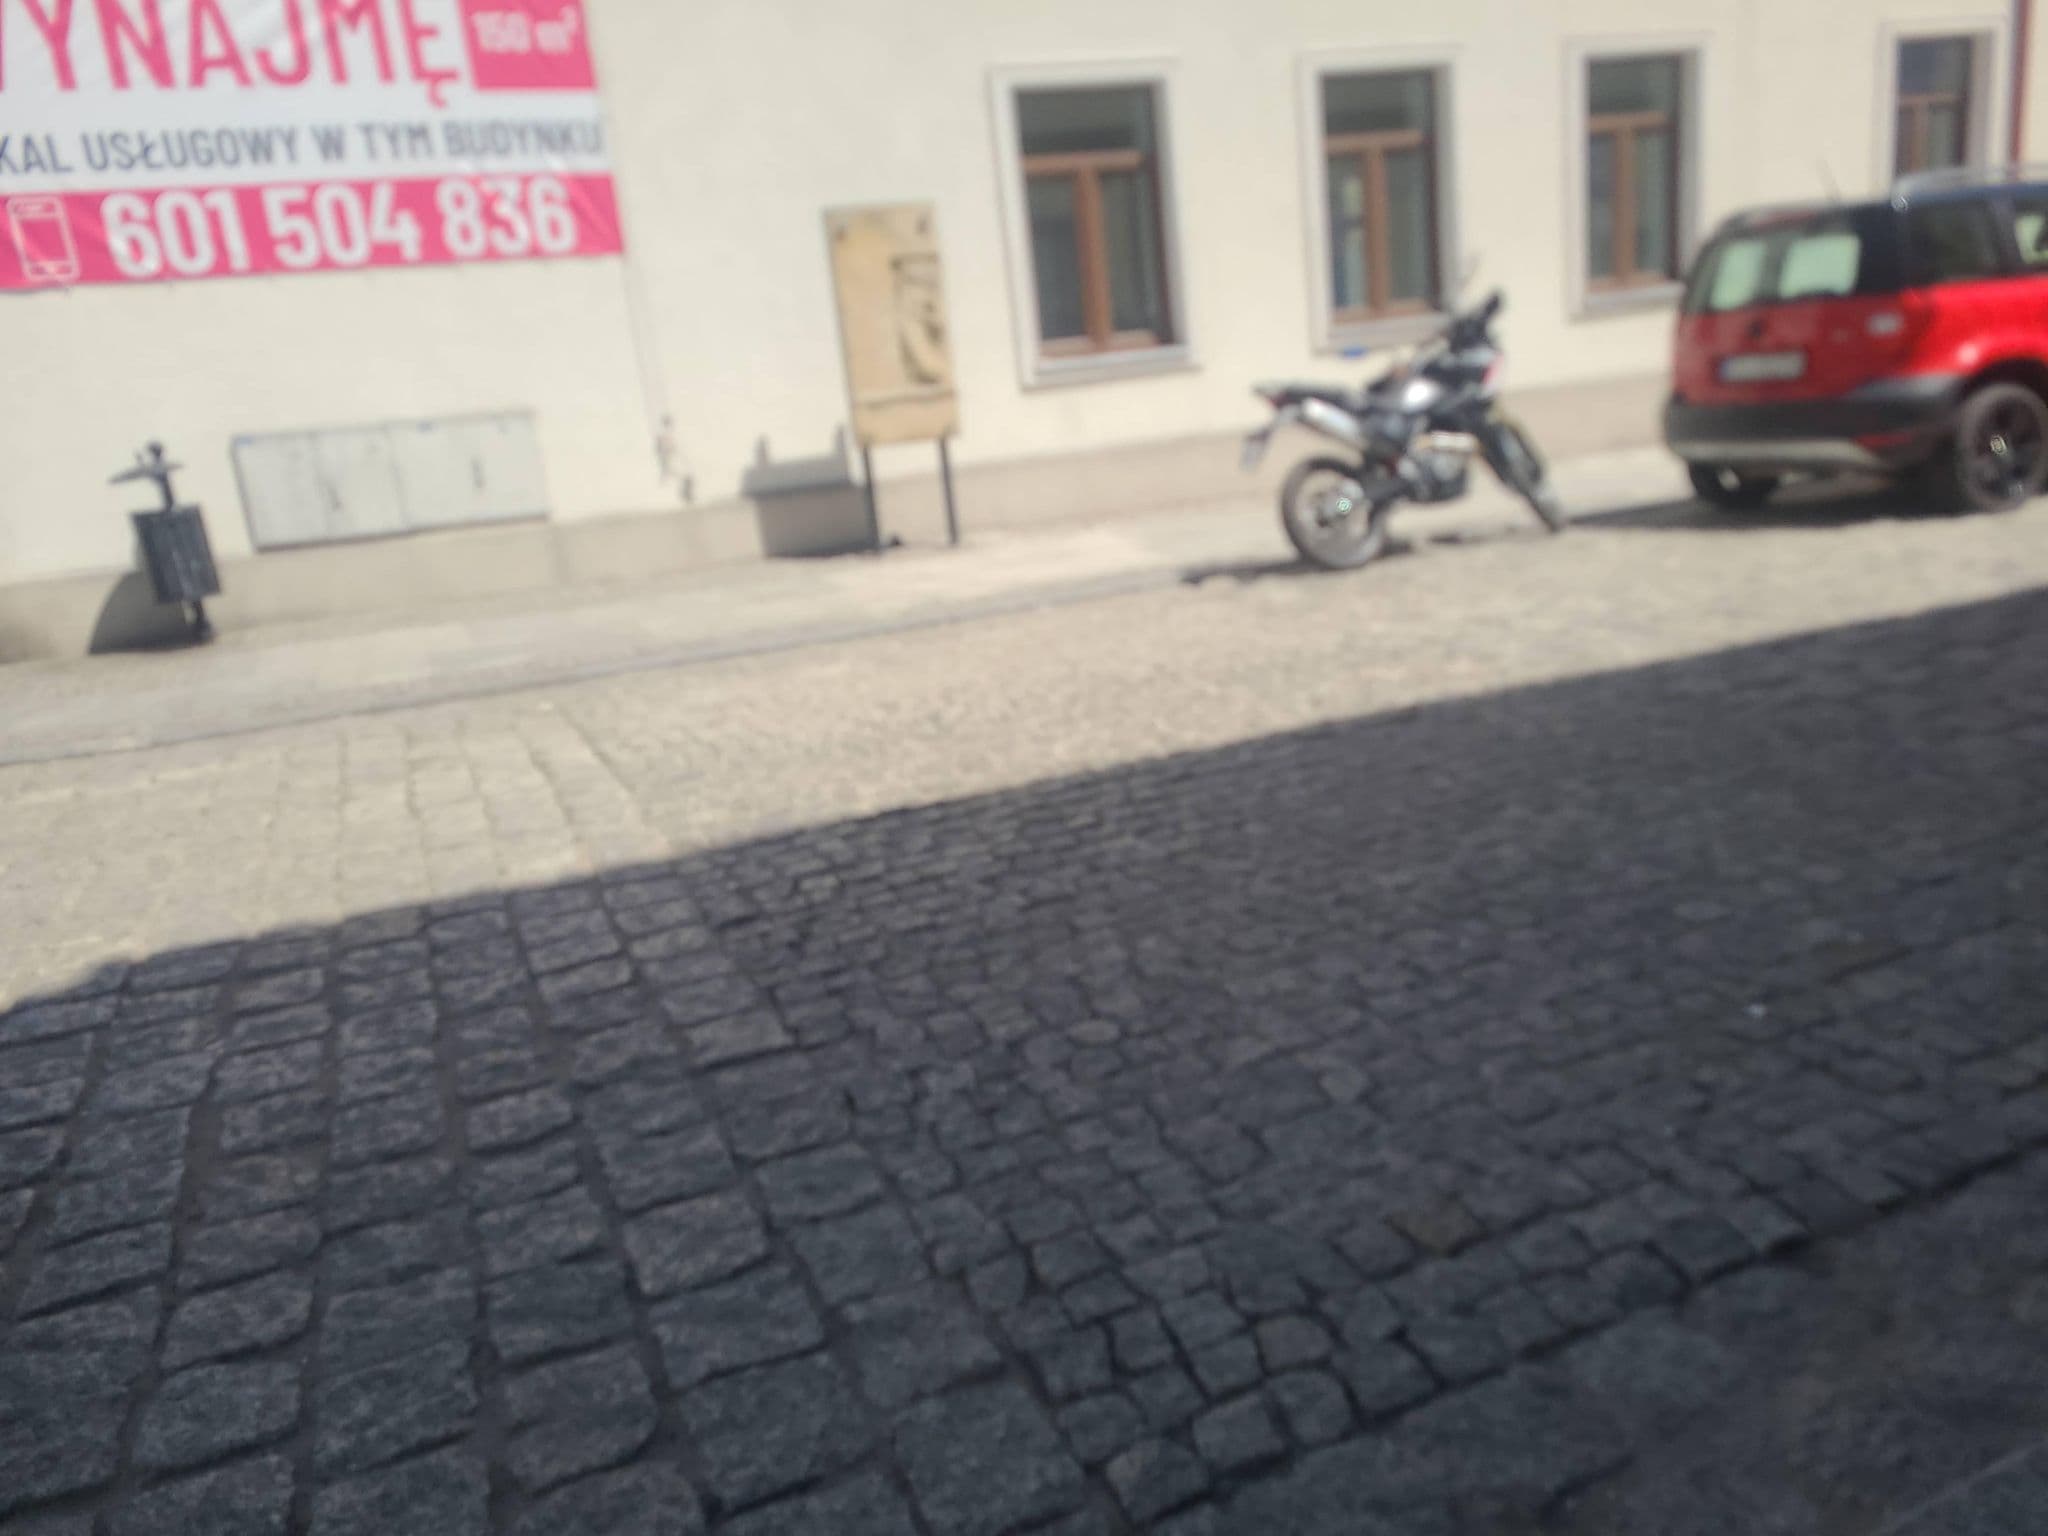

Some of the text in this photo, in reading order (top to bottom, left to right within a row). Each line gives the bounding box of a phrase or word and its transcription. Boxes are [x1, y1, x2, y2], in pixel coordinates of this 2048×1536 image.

[0, 0, 458, 107] YNAJMĘ
[81, 127, 299, 173] USŁUGOWY
[310, 124, 345, 162] W
[356, 123, 433, 160] TYM
[441, 119, 605, 156] BUDYNKU
[100, 175, 577, 277] 601 504 836
